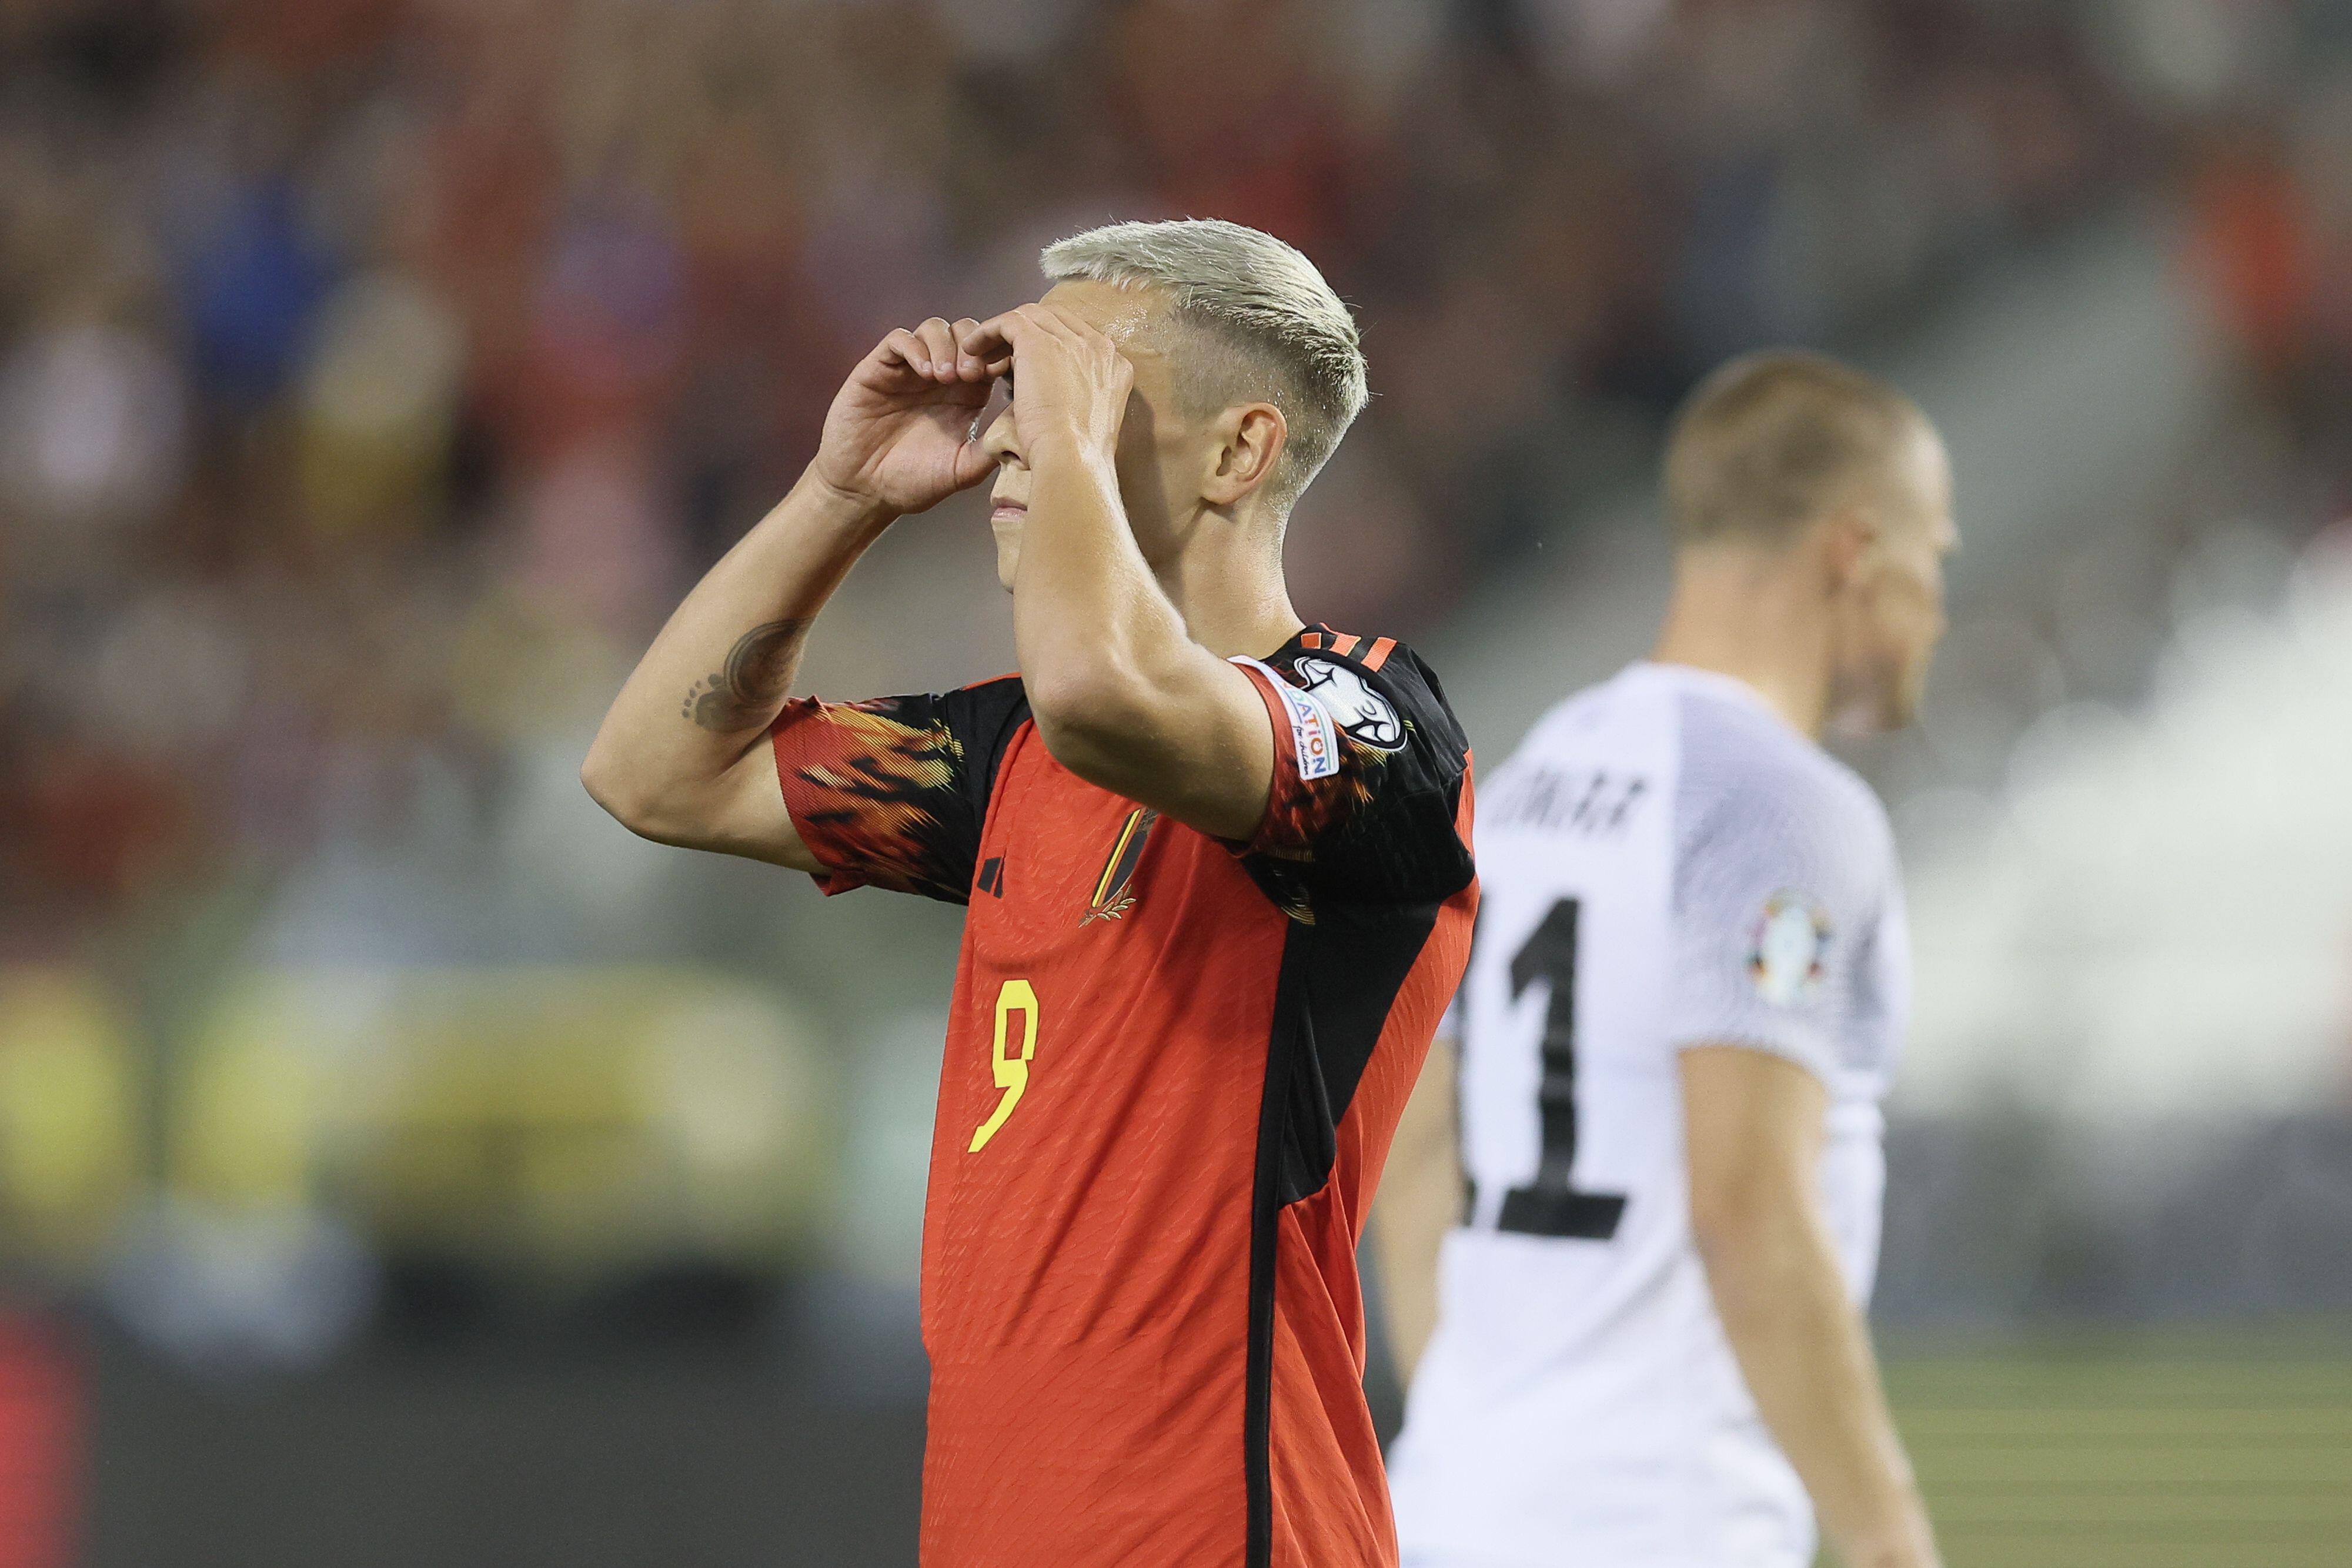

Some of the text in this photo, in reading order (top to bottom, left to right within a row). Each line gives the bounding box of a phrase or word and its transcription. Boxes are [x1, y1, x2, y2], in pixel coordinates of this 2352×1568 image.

[1292, 726, 1309, 775] for children
[967, 979, 1038, 1153] 9
